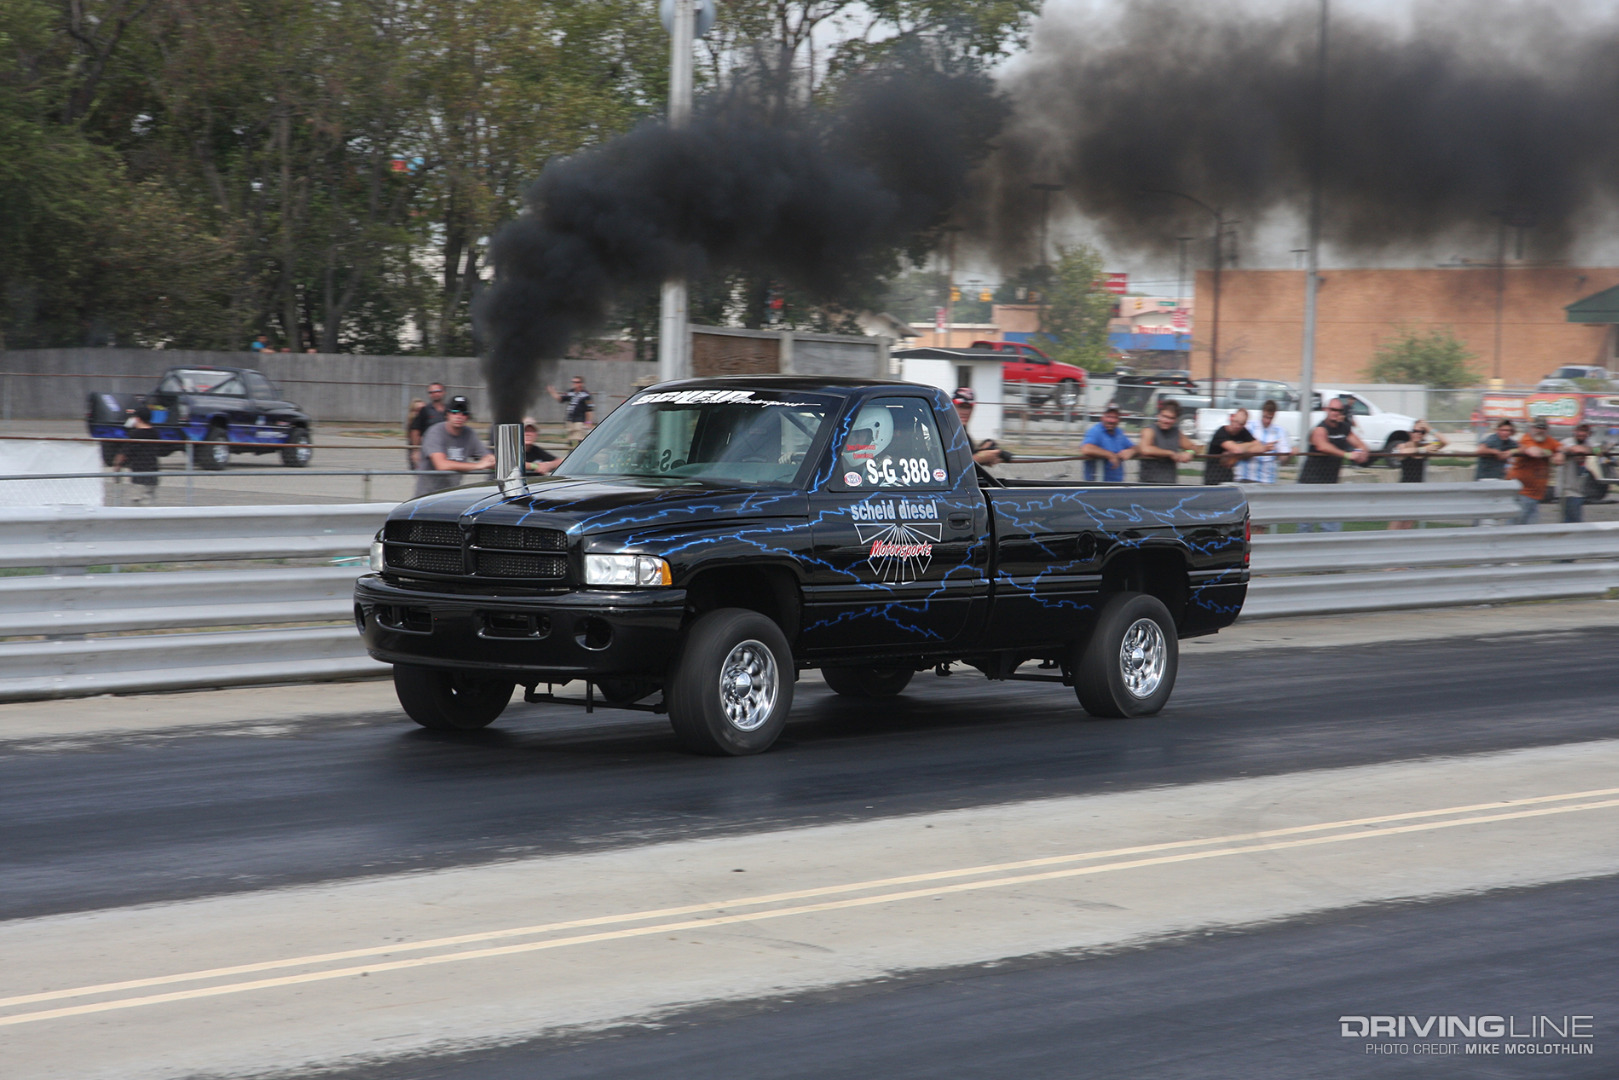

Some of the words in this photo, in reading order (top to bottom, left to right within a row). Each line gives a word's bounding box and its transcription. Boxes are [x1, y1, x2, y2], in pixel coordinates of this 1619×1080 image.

[866, 458, 897, 484] S-G
[899, 458, 931, 483] 388
[850, 499, 896, 520] scheid
[898, 499, 939, 520] diesel
[869, 540, 932, 561] Motorsports
